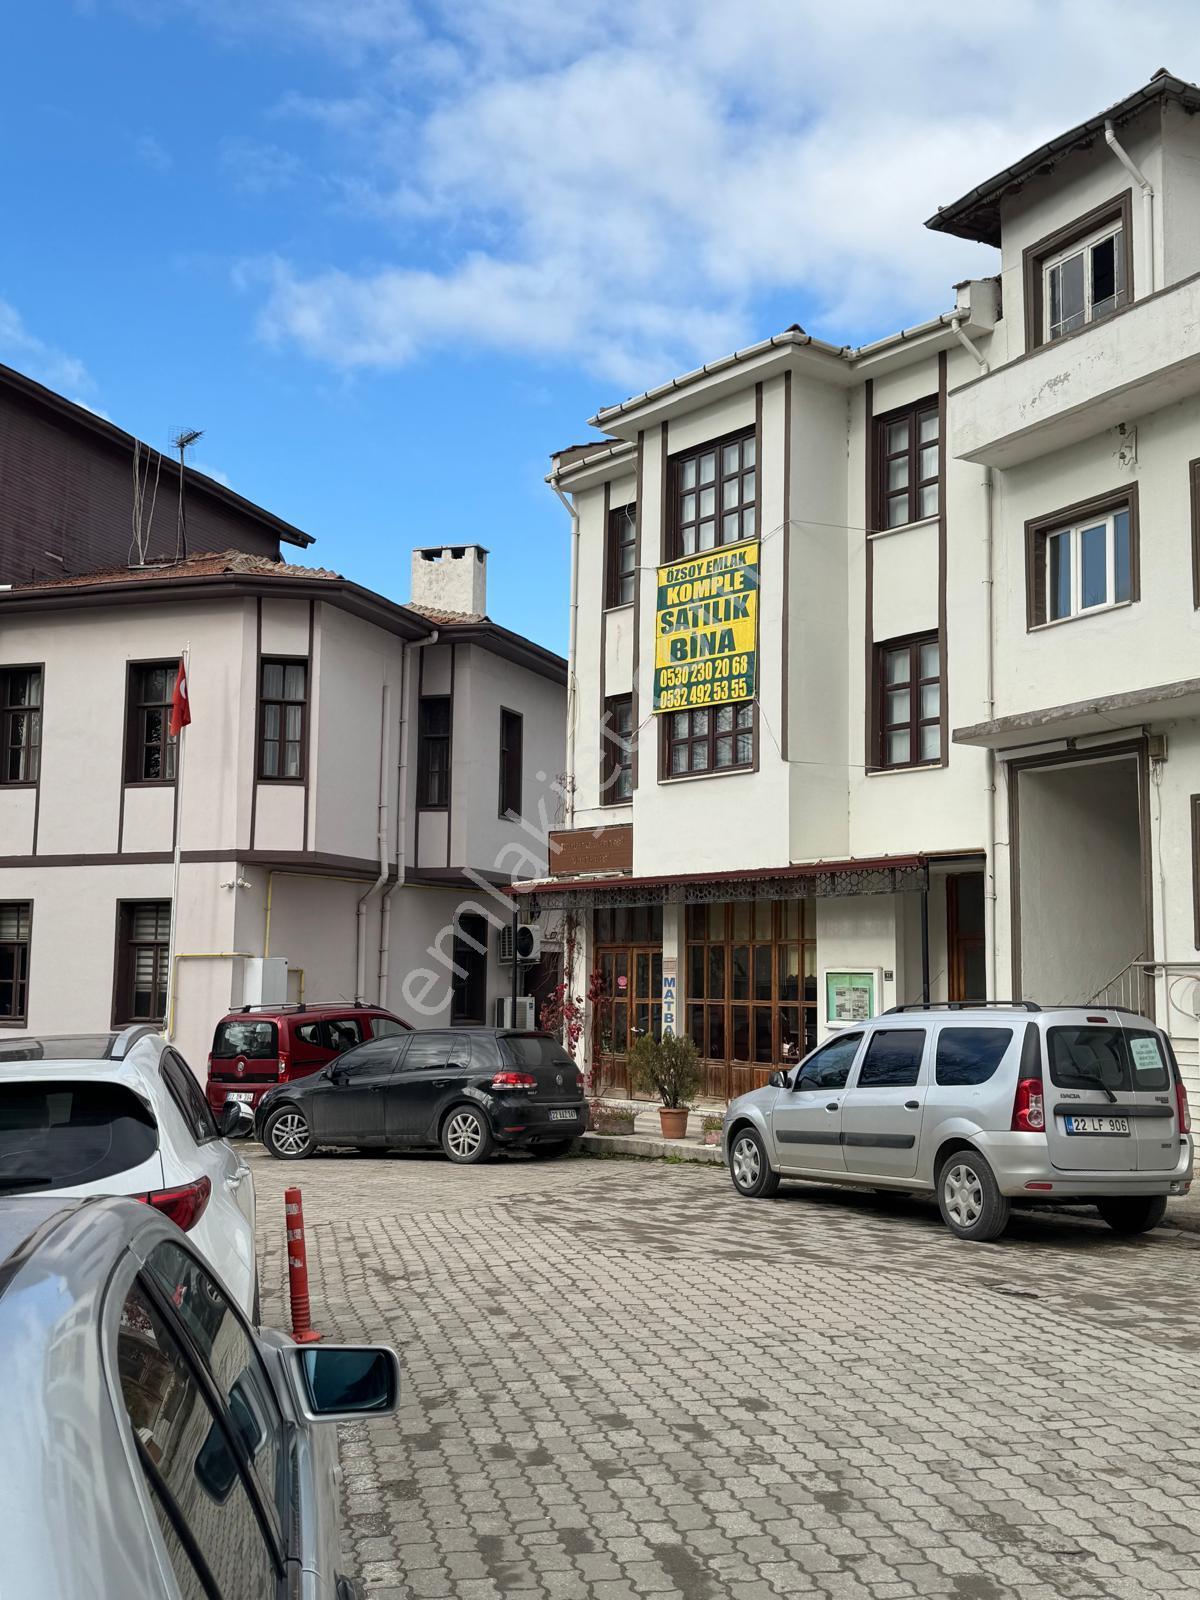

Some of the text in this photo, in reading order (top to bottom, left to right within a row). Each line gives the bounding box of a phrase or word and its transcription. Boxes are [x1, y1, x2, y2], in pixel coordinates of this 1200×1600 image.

[666, 551, 747, 583] ÖZSOY EMLAK
[667, 571, 744, 605] KOMPLE
[661, 594, 750, 634] SATILIK
[670, 628, 736, 662] BİNA
[660, 655, 748, 688] 0530 230 20 68
[660, 677, 747, 709] 0532 492 53 55
[1074, 1118, 1127, 1132] 22 LF 906
